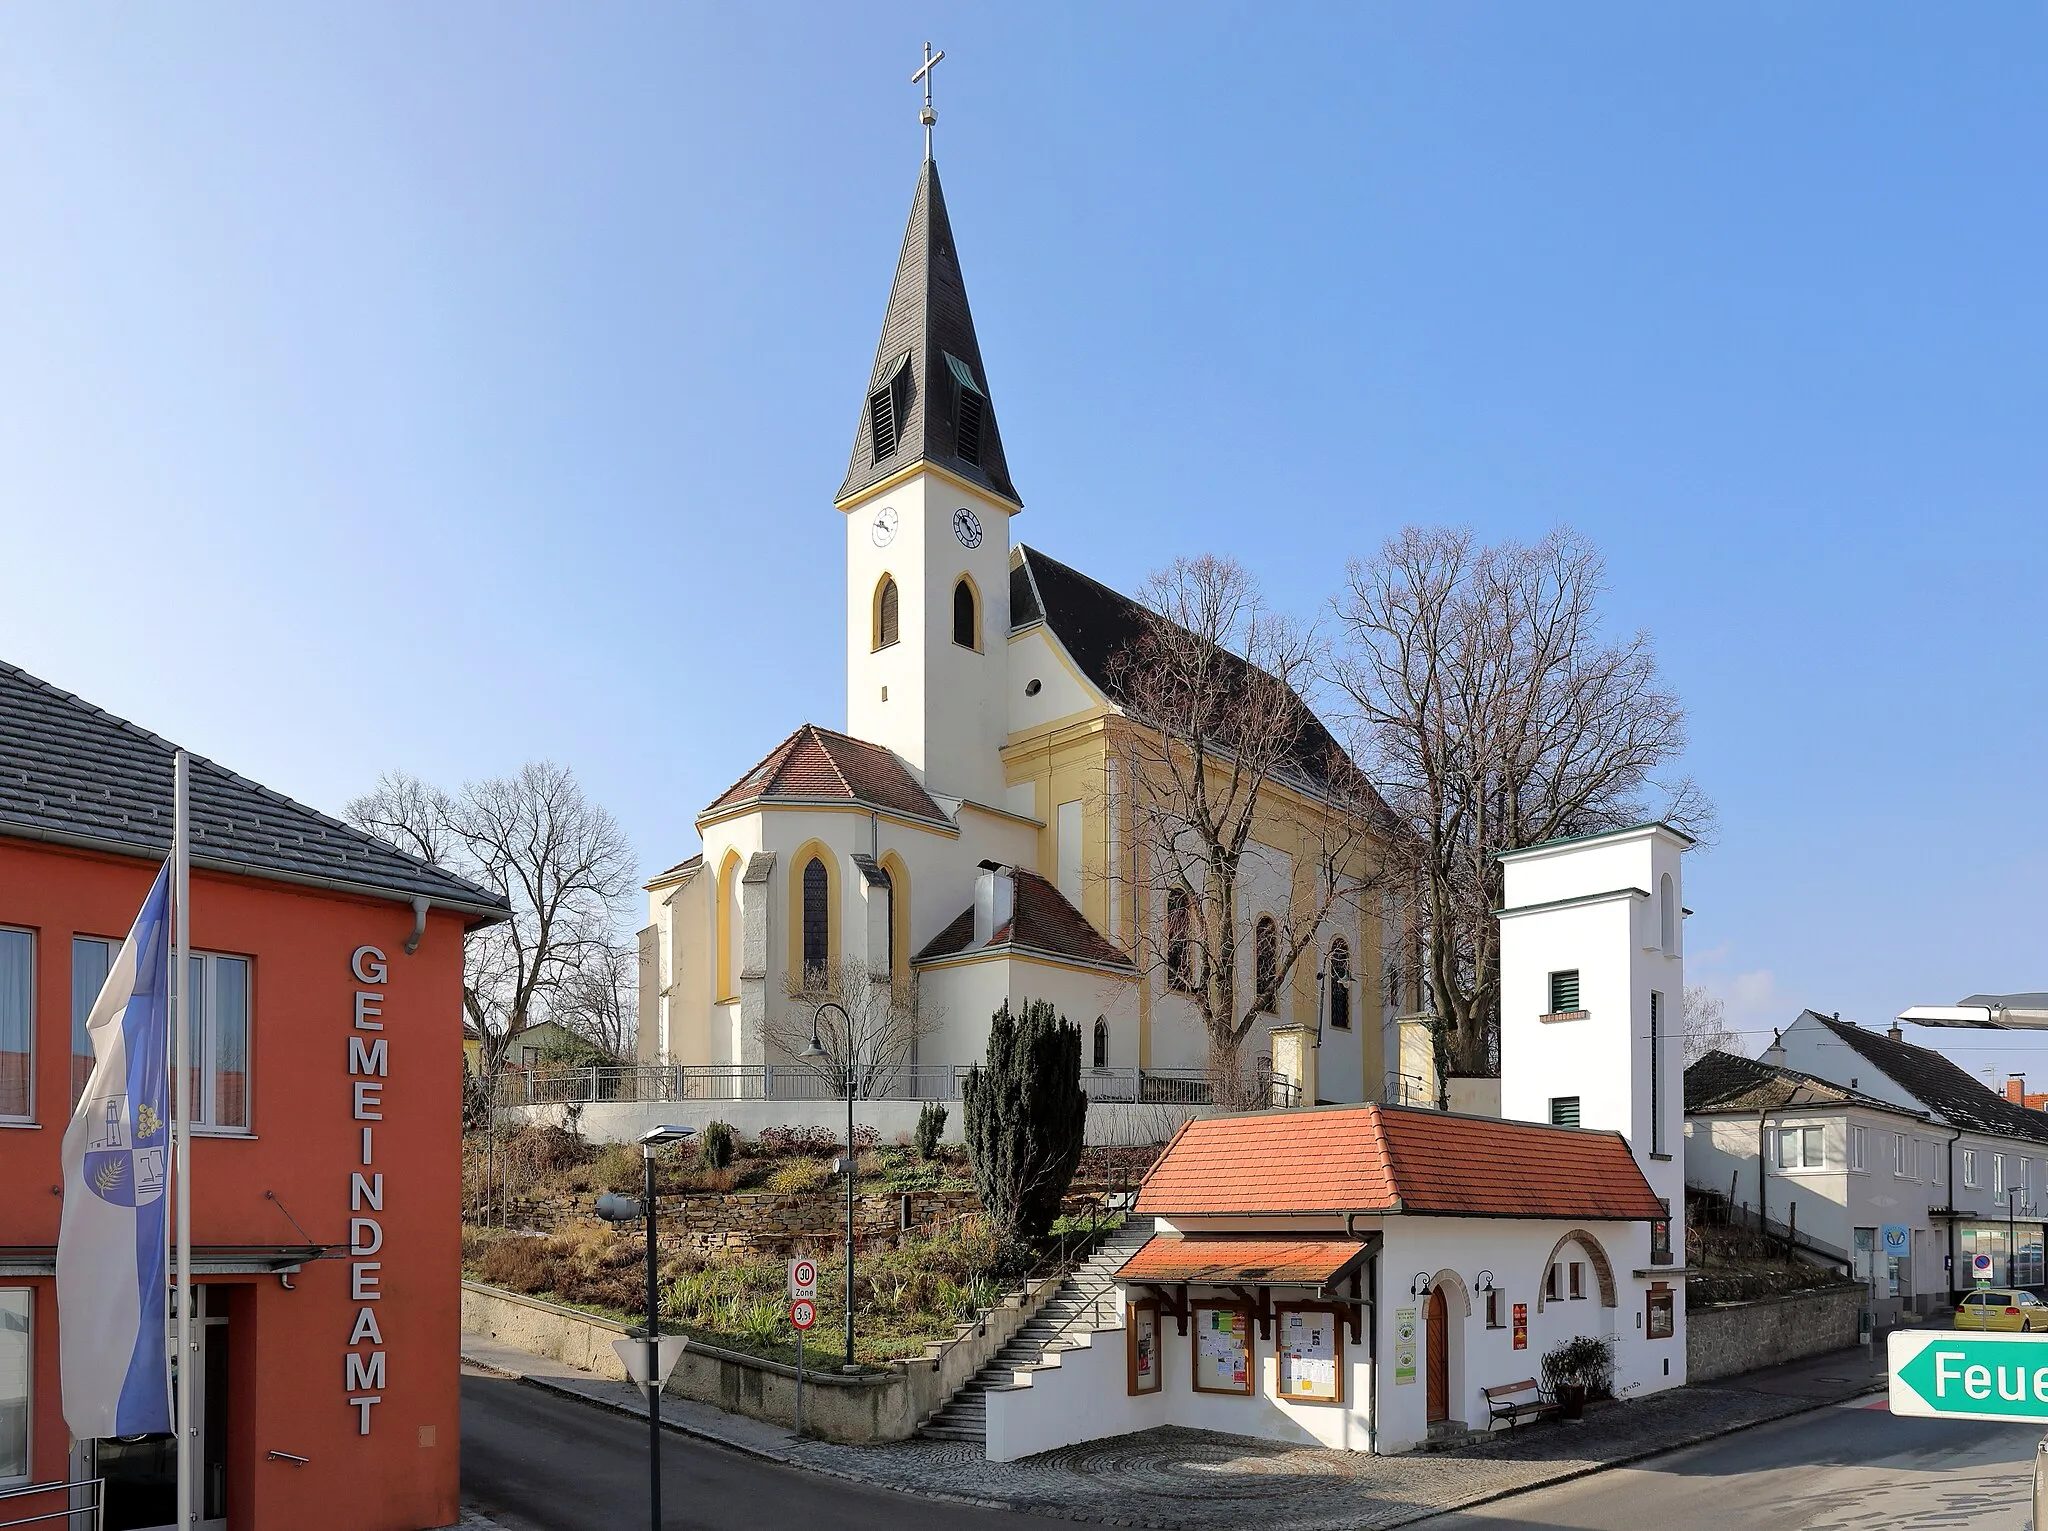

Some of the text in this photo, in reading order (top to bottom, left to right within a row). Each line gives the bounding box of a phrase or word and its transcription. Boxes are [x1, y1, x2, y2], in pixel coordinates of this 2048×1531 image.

[346, 945, 388, 1435] GEMEINDEAMT
[800, 1269, 810, 1280] 30
[796, 1289, 813, 1297] Zone
